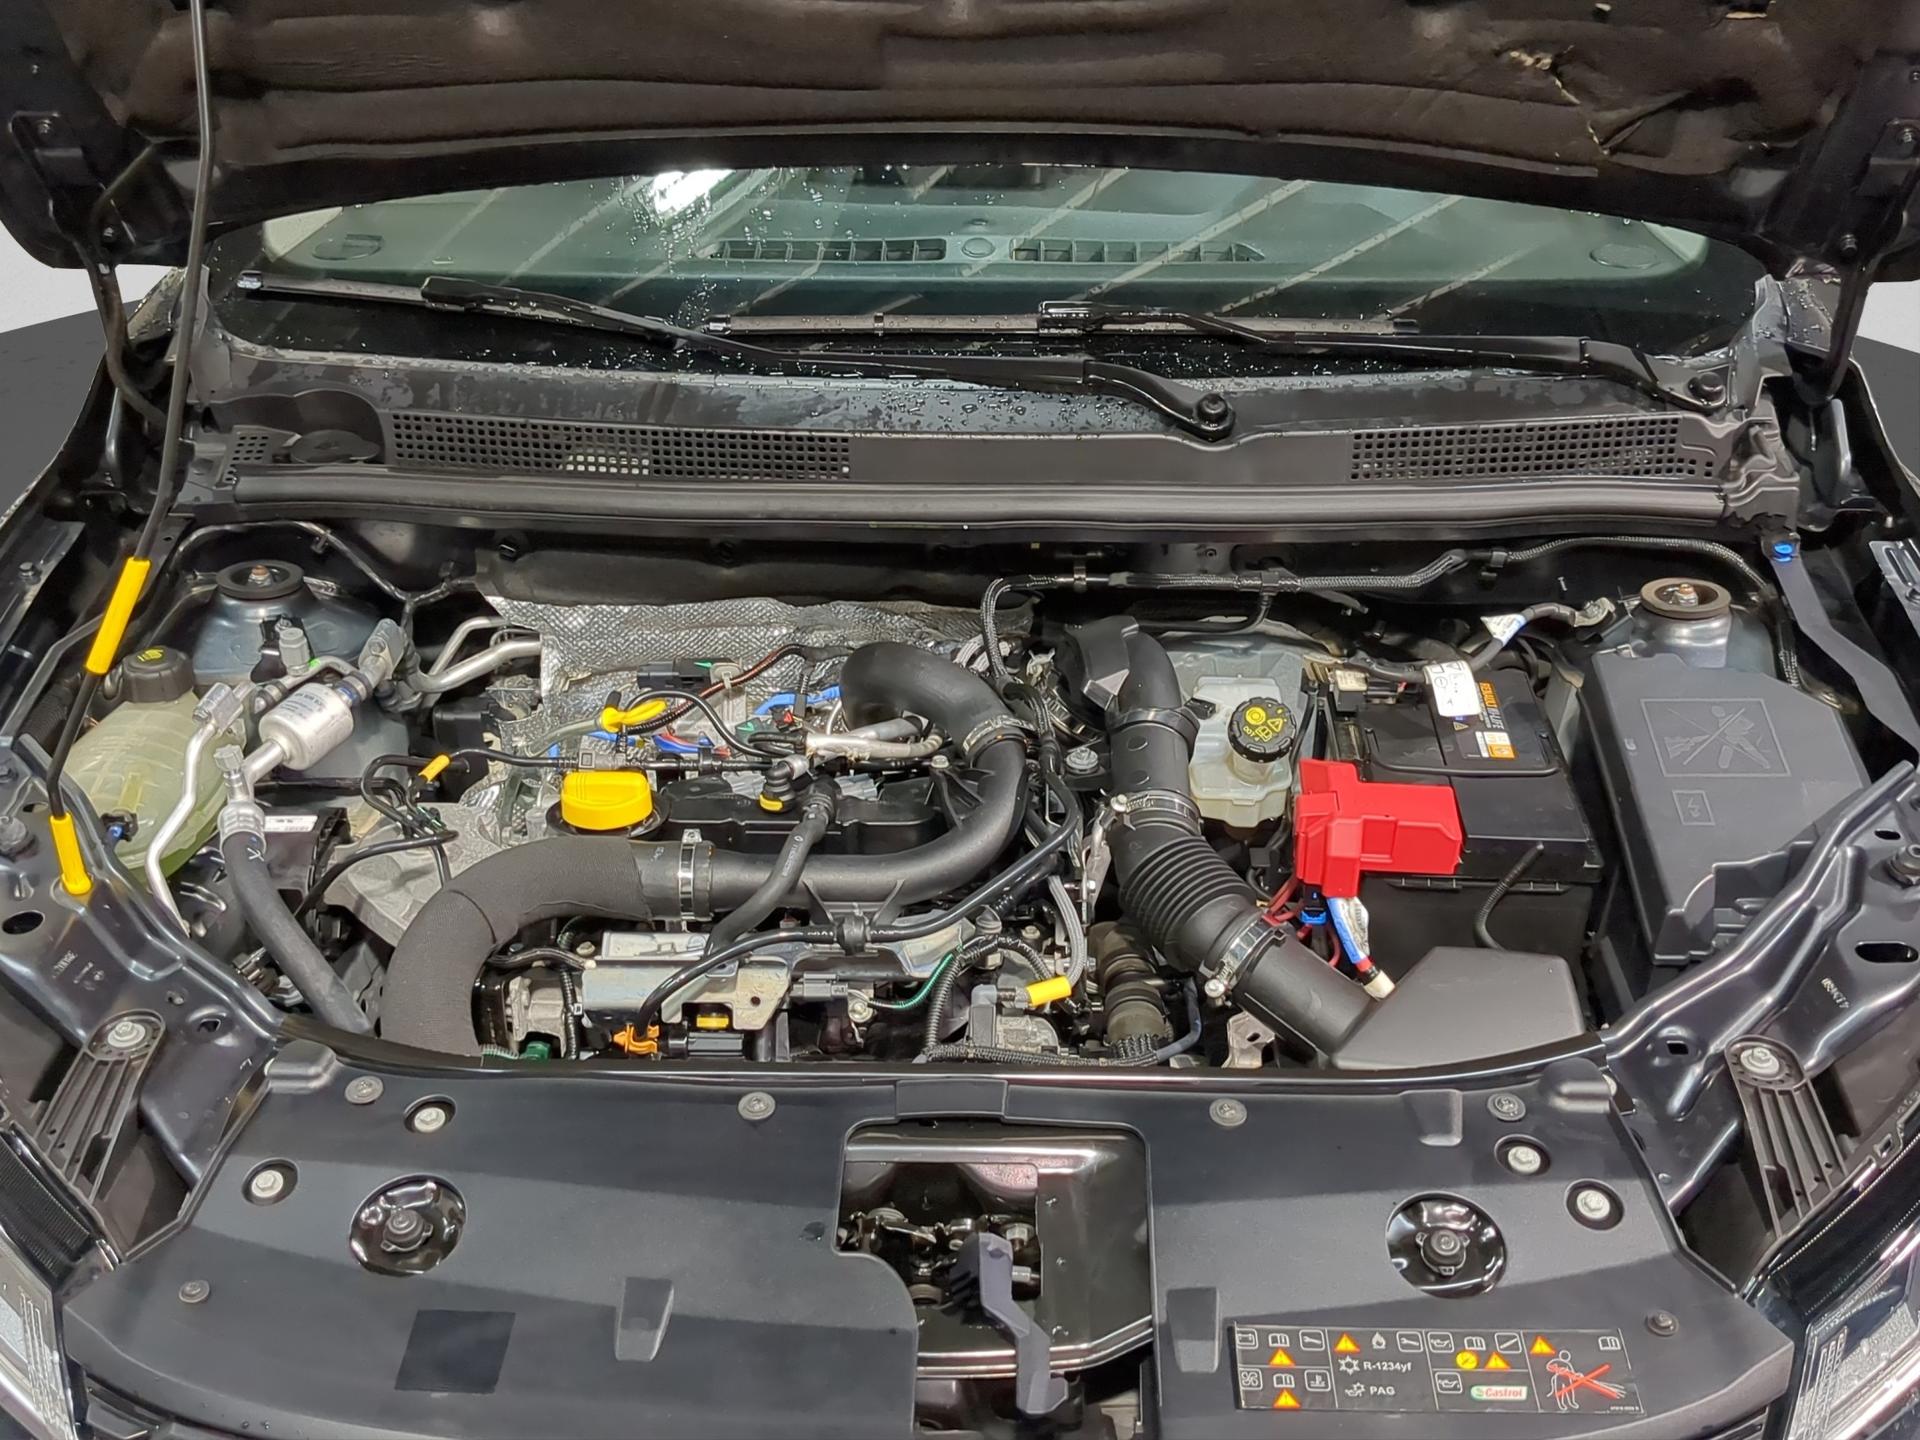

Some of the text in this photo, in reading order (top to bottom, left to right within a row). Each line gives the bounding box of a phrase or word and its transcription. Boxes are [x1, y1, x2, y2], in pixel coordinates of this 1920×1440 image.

[1363, 1361, 1412, 1374] R-1234yf
[1369, 1385, 1396, 1396] PAG
[1485, 1387, 1522, 1397] Castrol
